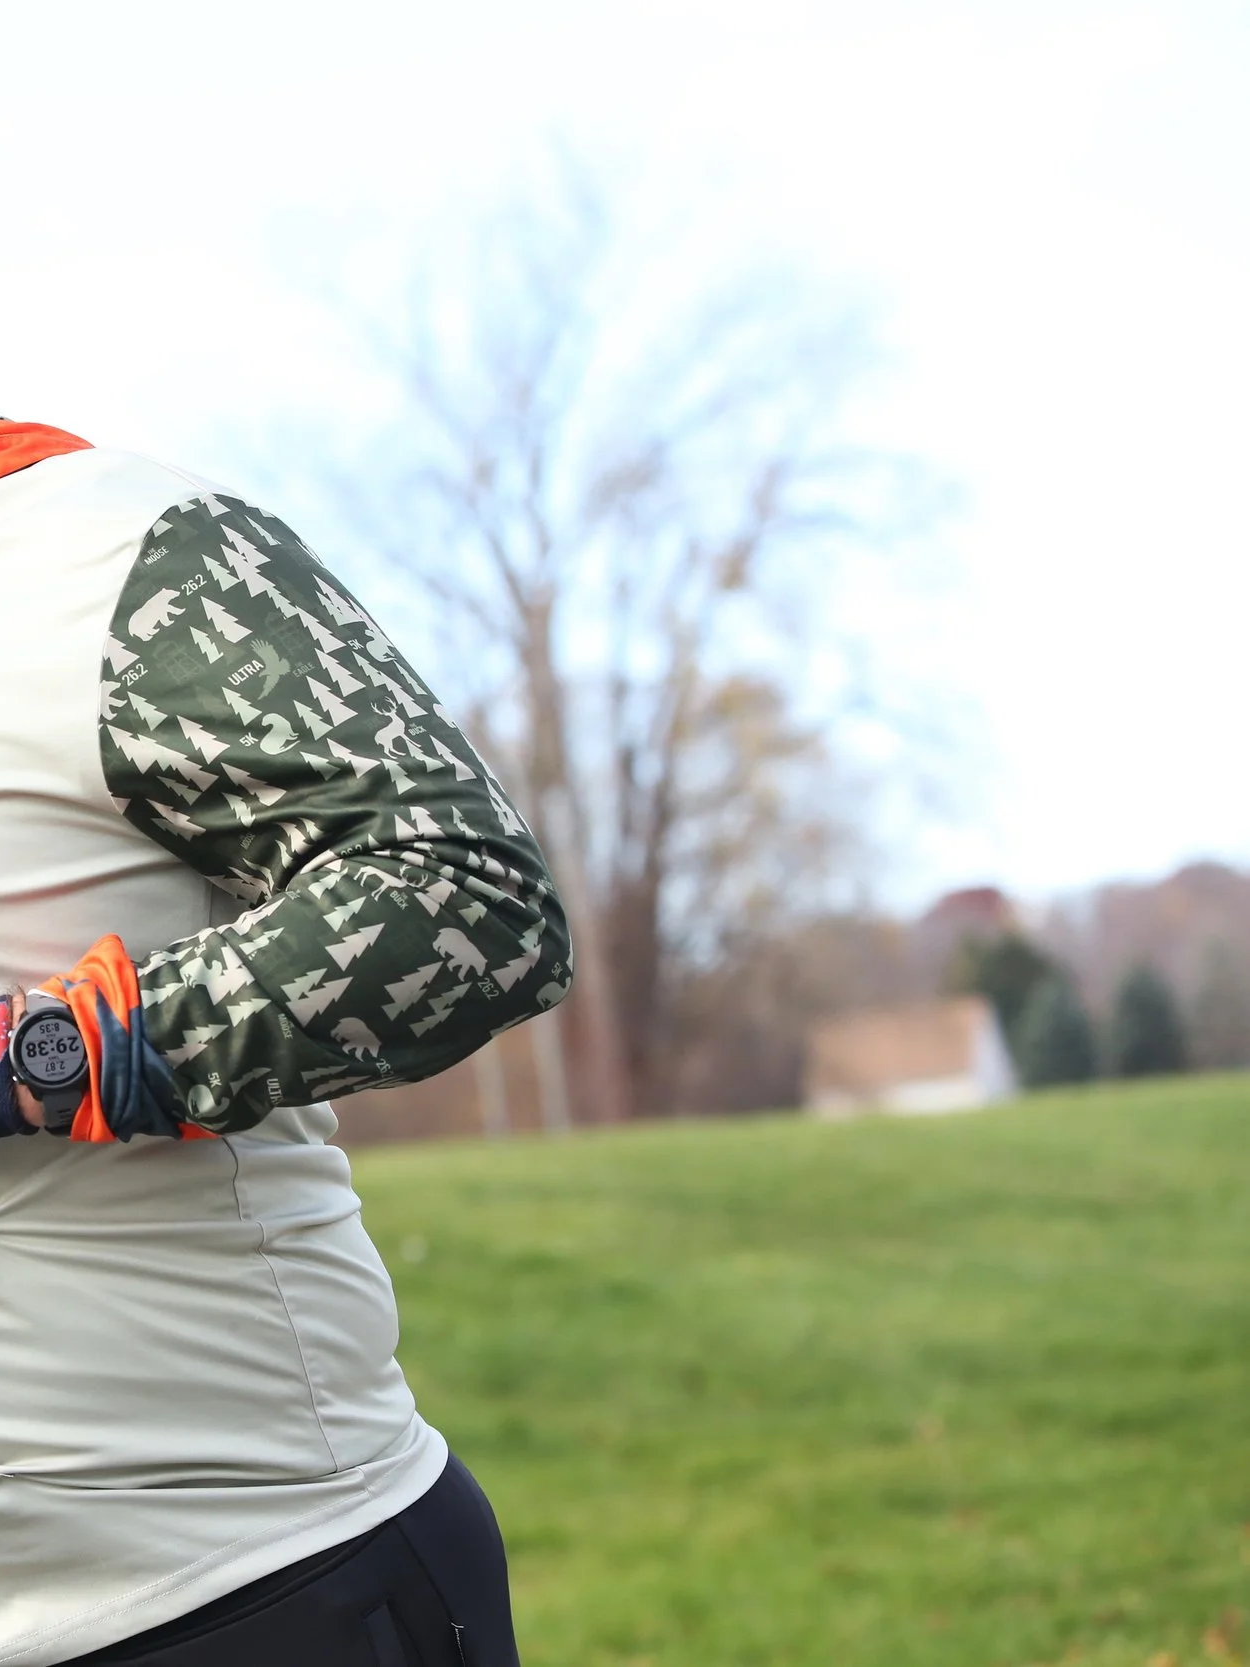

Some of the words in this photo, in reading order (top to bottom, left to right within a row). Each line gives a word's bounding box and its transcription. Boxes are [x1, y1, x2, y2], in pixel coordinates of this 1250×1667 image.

[144, 545, 170, 566] MOOSE
[181, 574, 208, 596] 26.2
[347, 638, 365, 651] 5K
[121, 663, 149, 687] 26.2
[227, 659, 265, 686] ULTRA
[239, 731, 259, 748] 5K
[389, 890, 410, 911] BUCK
[551, 961, 564, 979] 5K
[477, 977, 499, 1001] 26.2
[40, 1022, 60, 1035] 8:35
[277, 1013, 293, 1040] MOOSE
[26, 1036, 80, 1058] 29:38
[45, 1060, 66, 1073] 2.87
[208, 1072, 222, 1088] 5K
[266, 1078, 284, 1105] ULTR
